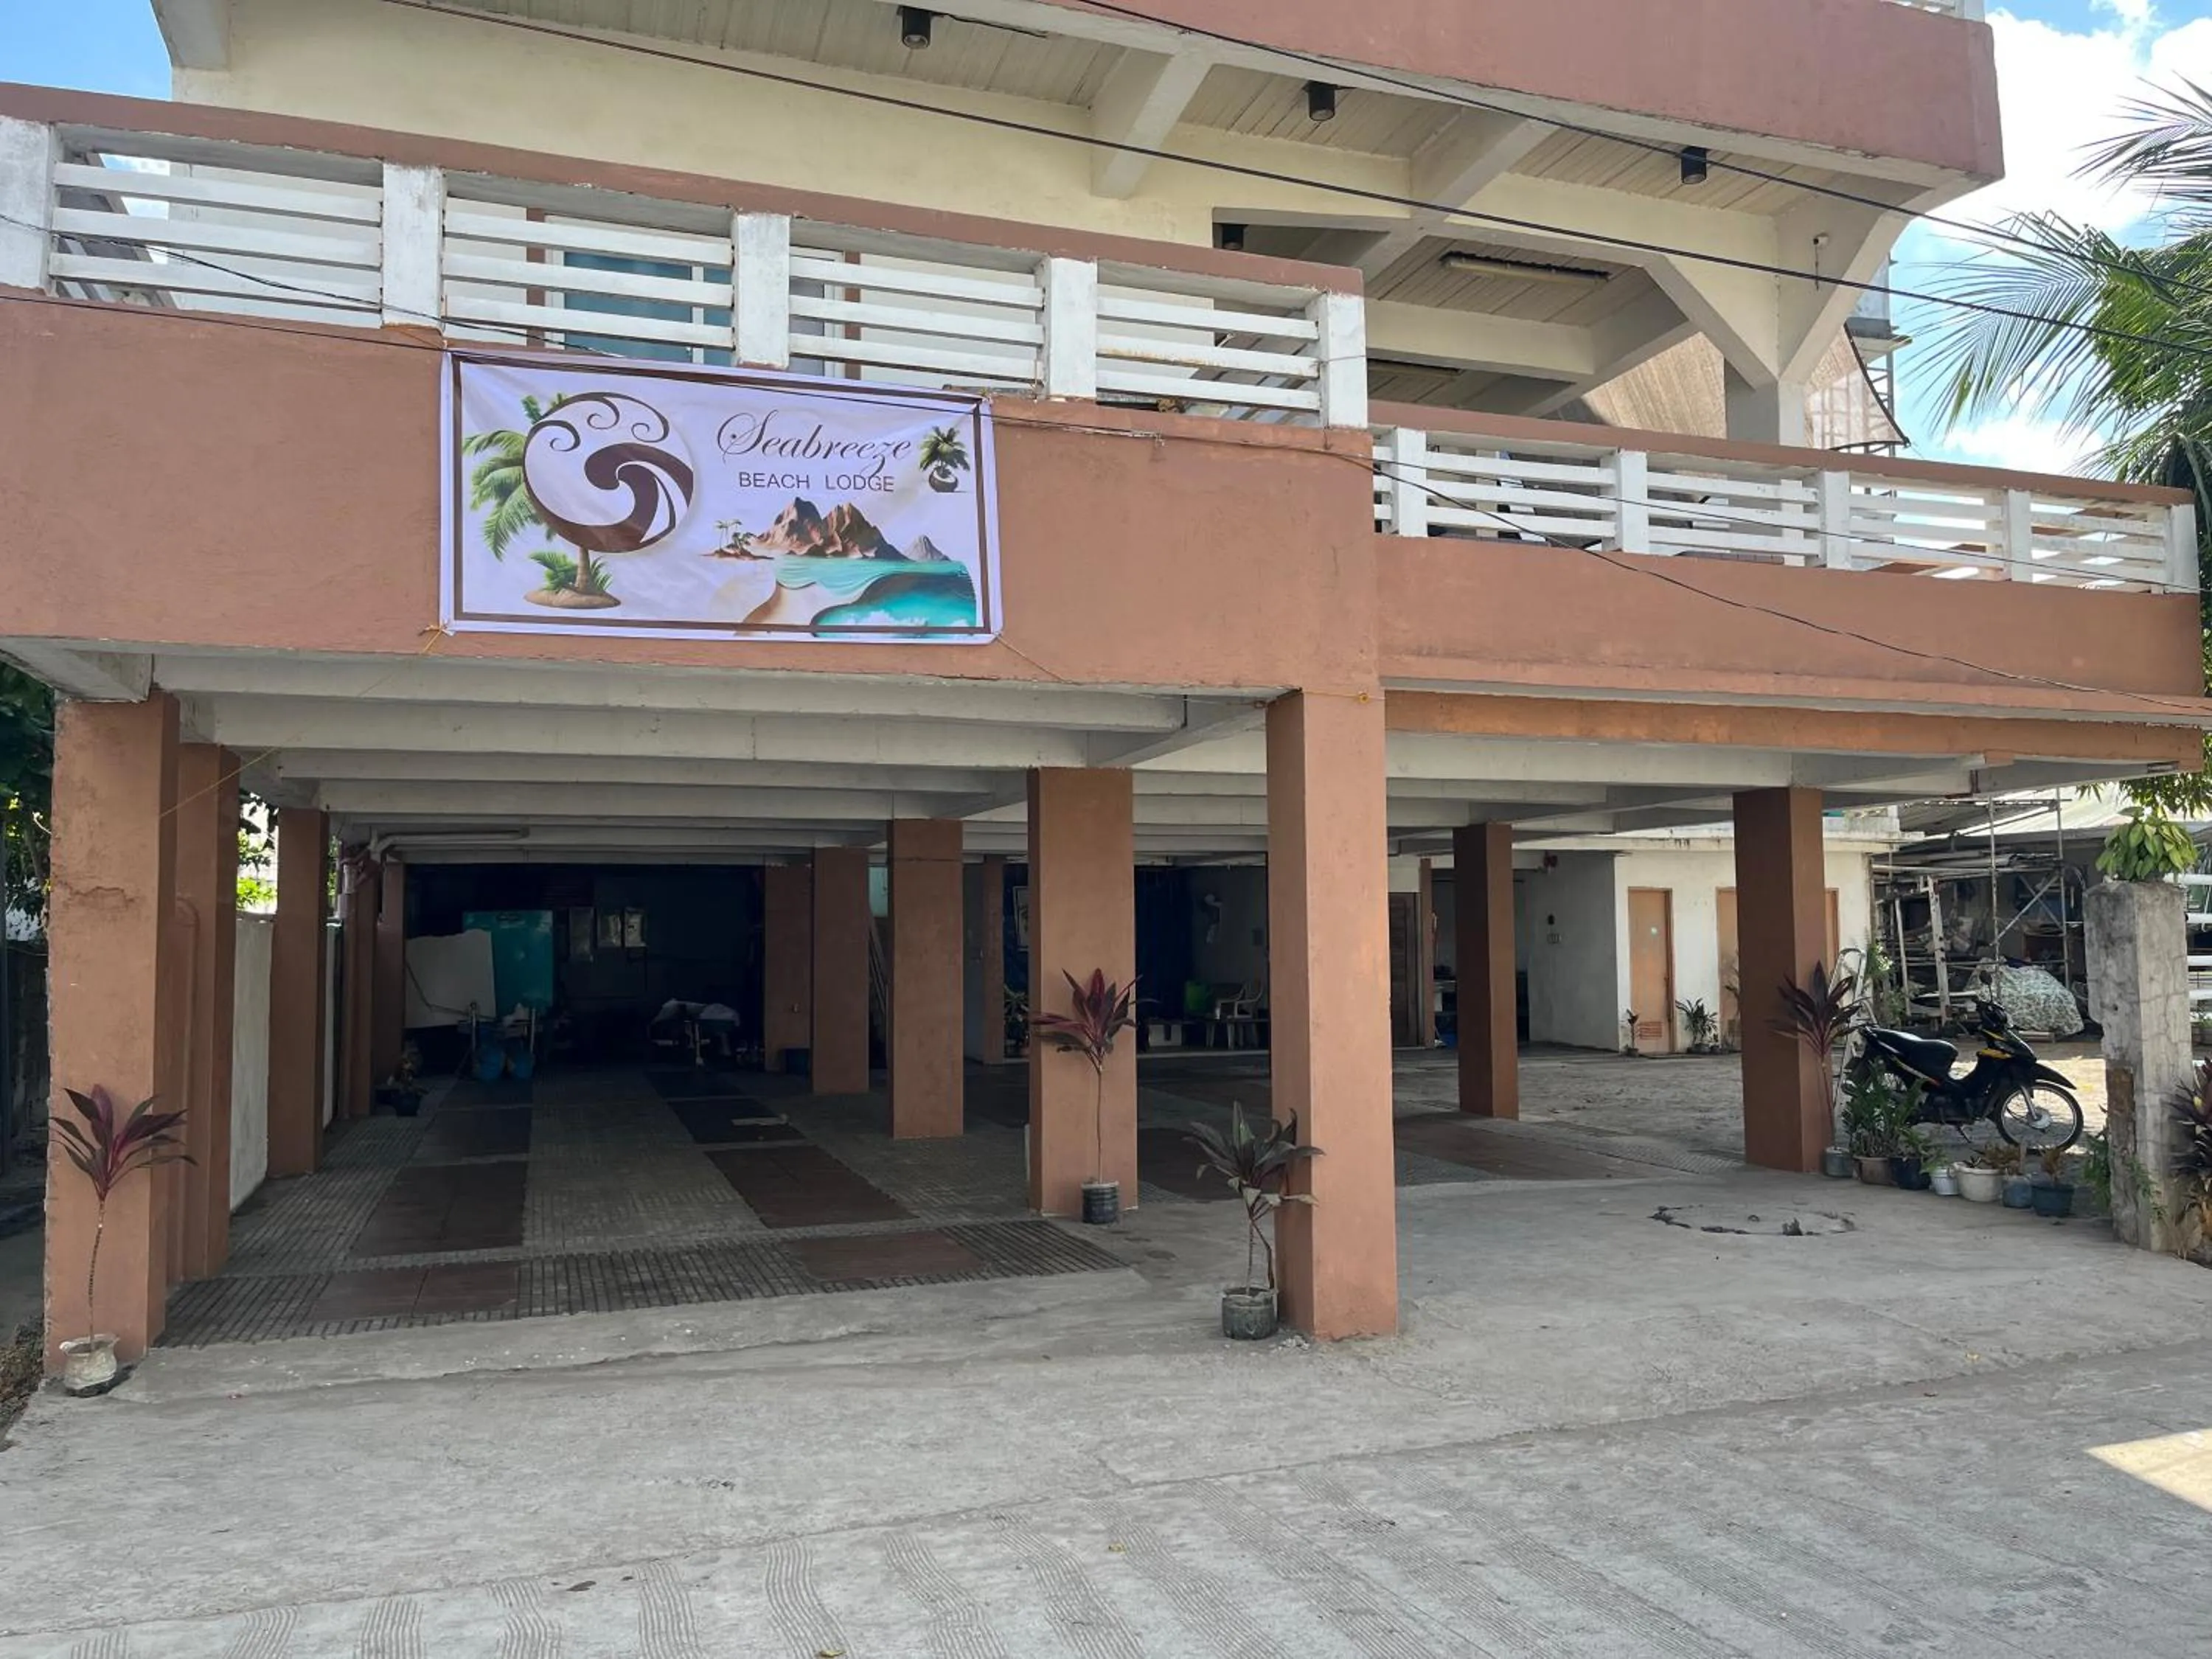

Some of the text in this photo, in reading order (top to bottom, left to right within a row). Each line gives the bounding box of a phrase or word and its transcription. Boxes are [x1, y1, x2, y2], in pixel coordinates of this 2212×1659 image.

[717, 410, 911, 476] Seabreeze
[739, 472, 895, 492] BEACH LODGE
